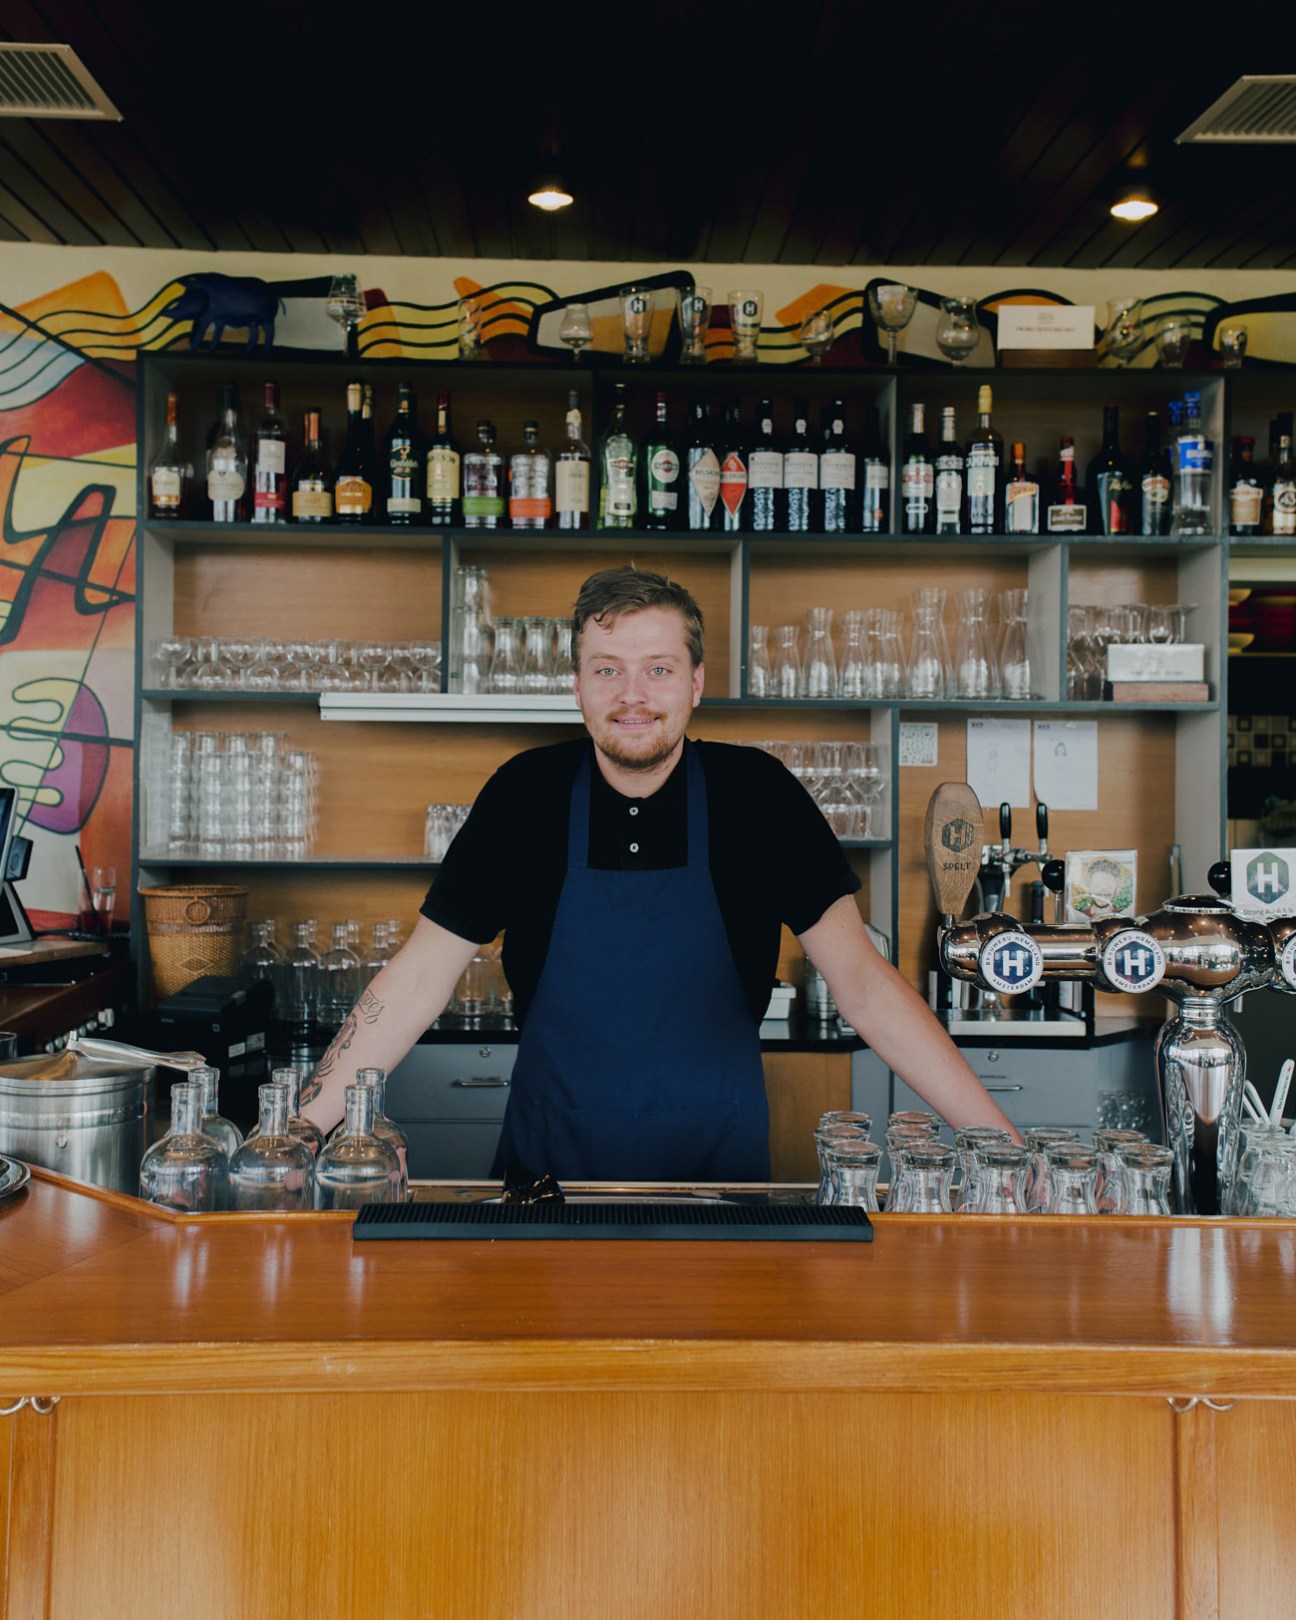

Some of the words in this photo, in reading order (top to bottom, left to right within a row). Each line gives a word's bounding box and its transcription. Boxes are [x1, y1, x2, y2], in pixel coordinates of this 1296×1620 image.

[943, 862, 972, 871] SPELT
[1257, 862, 1279, 894] H
[1002, 950, 1024, 977] H
[1124, 949, 1146, 976] H
[992, 977, 1034, 991] AMSTERDAM
[1114, 976, 1156, 990] AMSTERDAM
